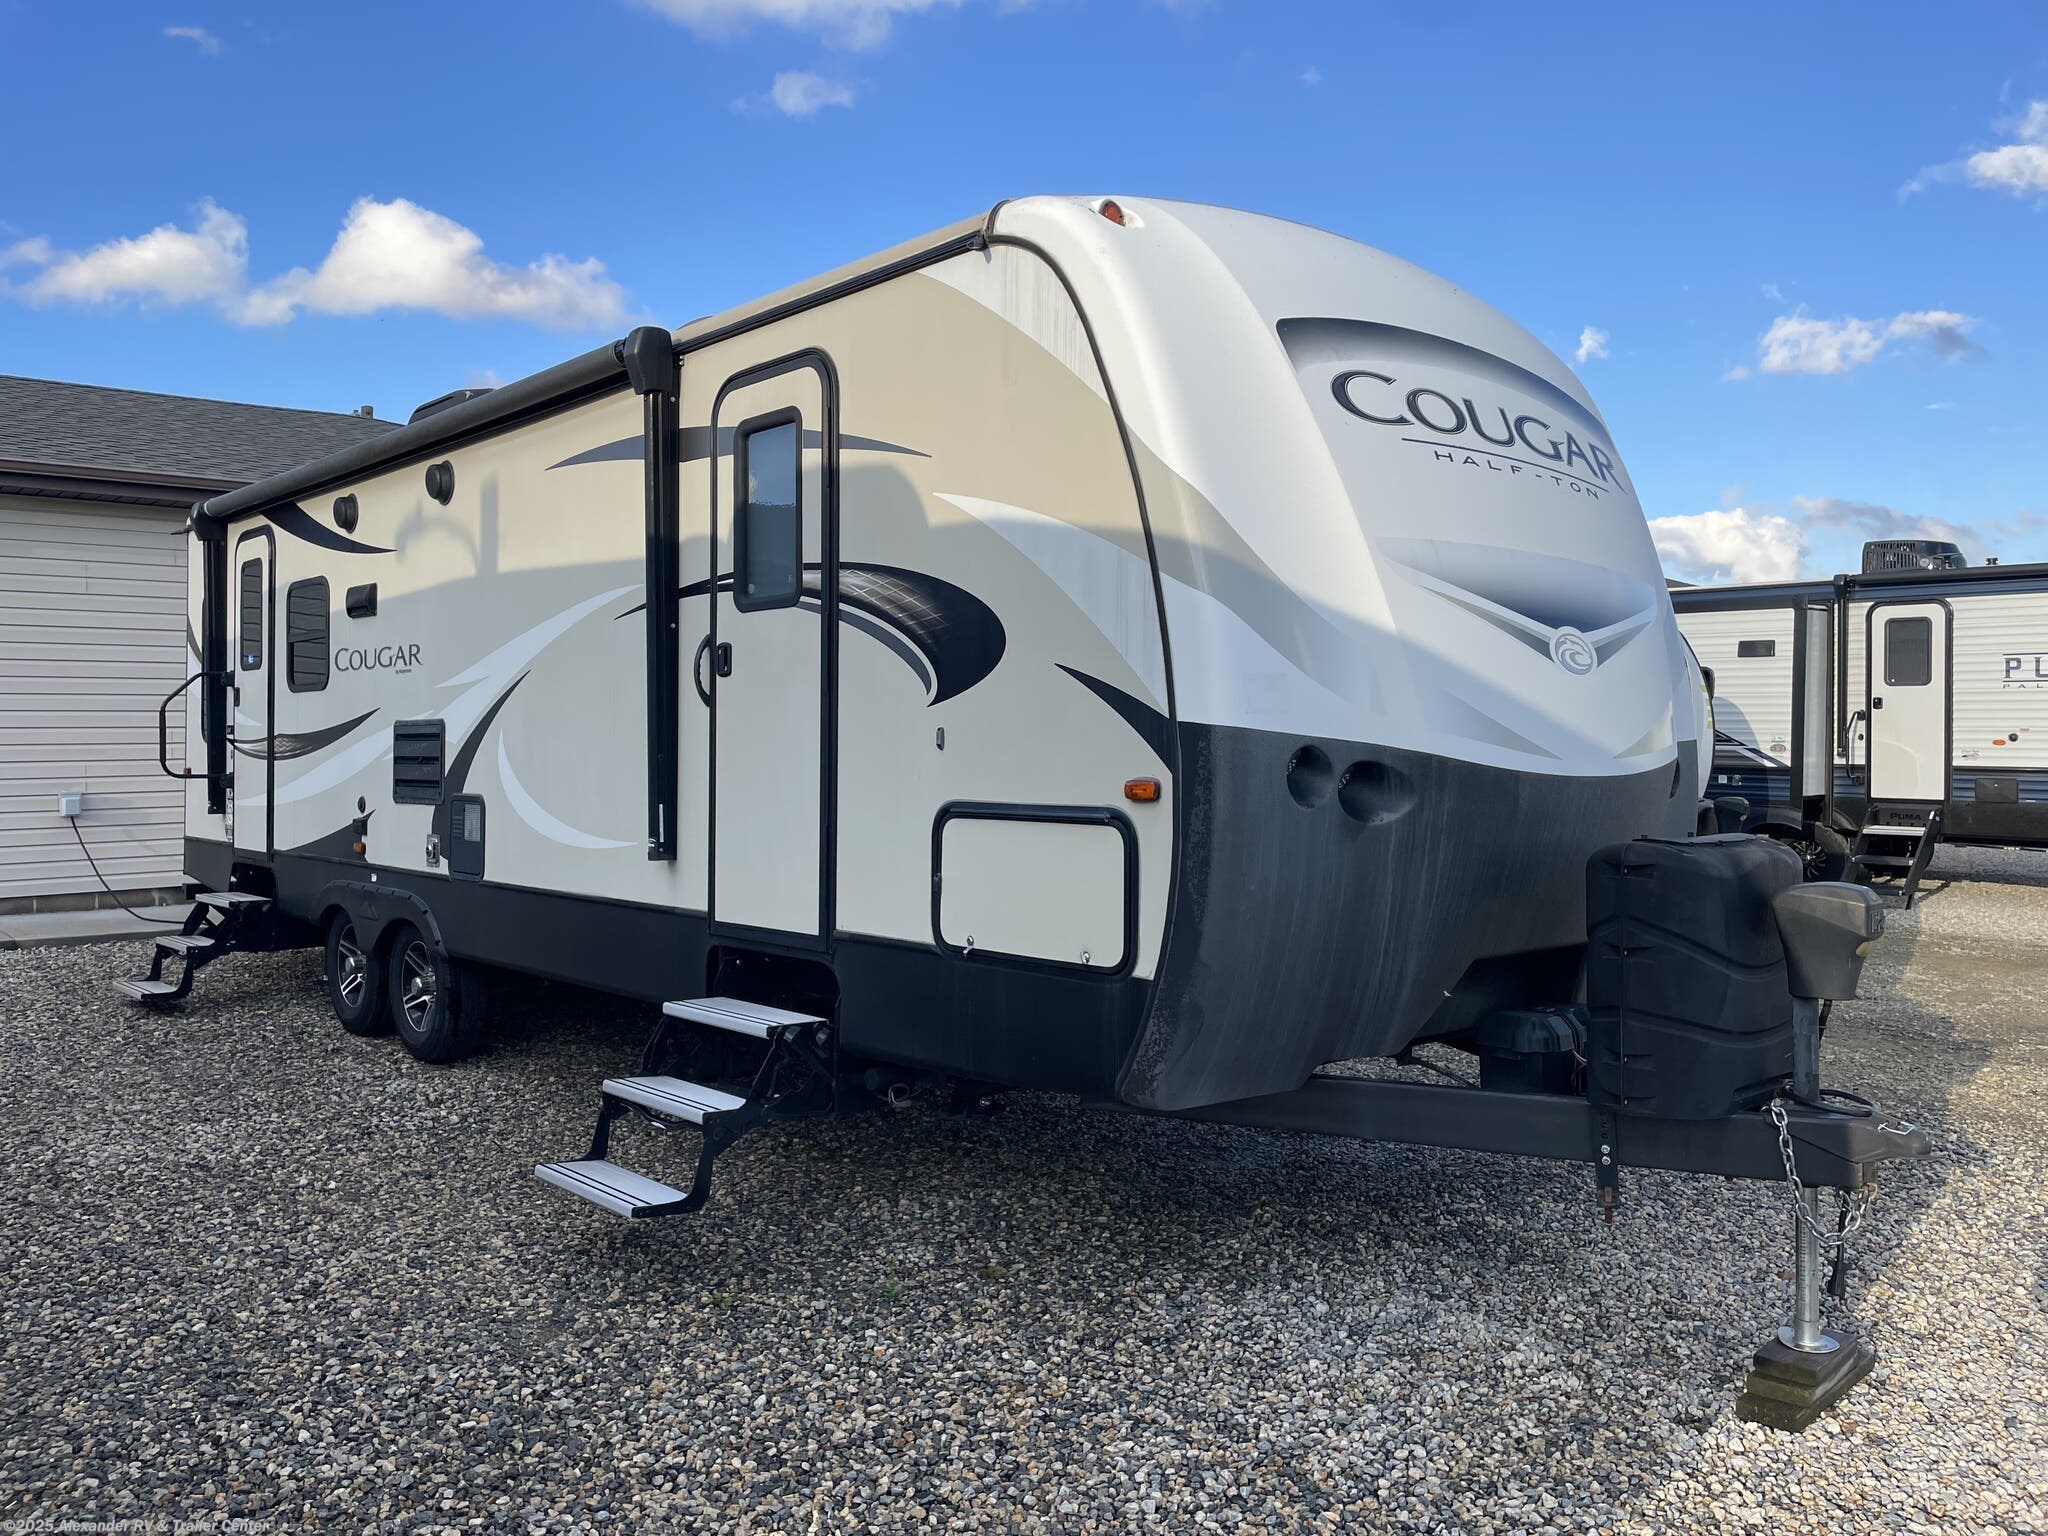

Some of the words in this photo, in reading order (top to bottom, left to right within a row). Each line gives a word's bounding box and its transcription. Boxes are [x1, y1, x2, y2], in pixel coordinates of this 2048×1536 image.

[1330, 369, 1628, 495] COUGAR
[1433, 450, 1600, 501] HALF-TON
[334, 643, 423, 672] COUGAR
